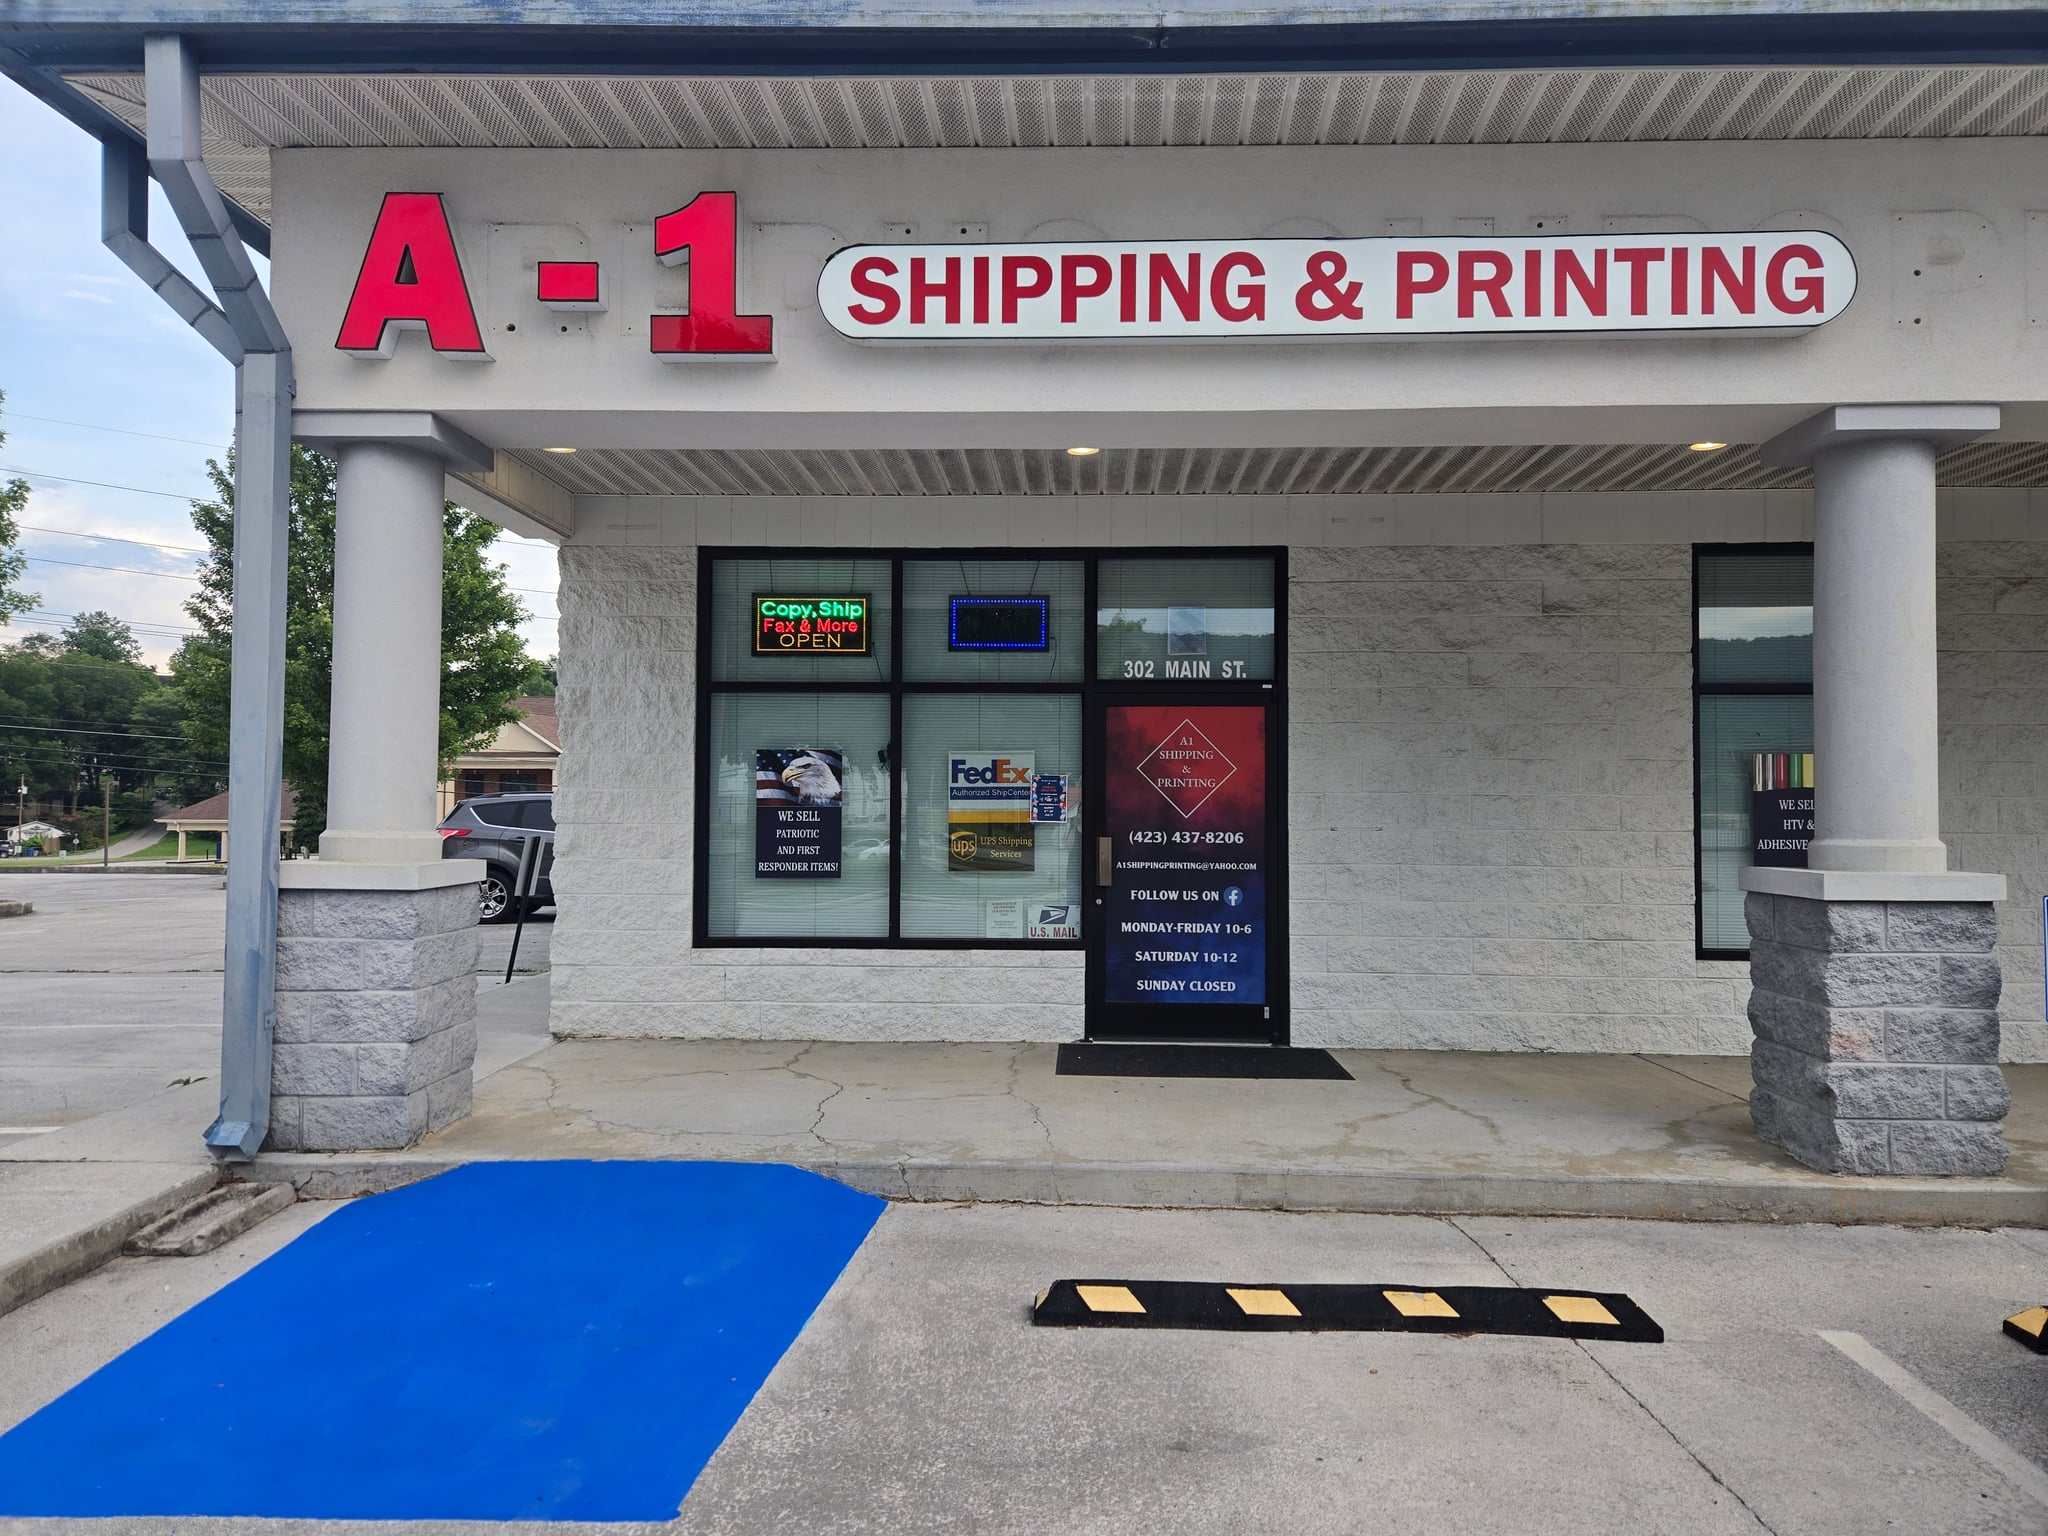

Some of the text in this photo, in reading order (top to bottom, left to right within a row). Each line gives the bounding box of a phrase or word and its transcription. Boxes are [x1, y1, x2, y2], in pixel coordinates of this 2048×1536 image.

[847, 243, 1826, 325] SHIPPING & PRINTING
[763, 618, 858, 633] Fax & More
[779, 633, 841, 648] OPEN
[1124, 660, 1247, 679] 302 MAIN ST.
[1180, 736, 1194, 746] A1
[1159, 750, 1214, 760] SHIPPING
[951, 759, 1031, 784] FedEx
[1182, 765, 1192, 774] &
[1157, 778, 1216, 788] PRINTING
[952, 788, 990, 796] Authorized
[991, 788, 1030, 798] ShipCente
[1779, 799, 1815, 810] WE SEL
[778, 810, 821, 822] WE SELL
[1783, 819, 1815, 830] HTV &
[776, 829, 820, 838] PATRIOTIC
[1129, 831, 1244, 845] (423) 437-8206
[980, 836, 1033, 848] UPS Shipping
[1757, 839, 1809, 850] ADHESIVE
[776, 845, 821, 855] AND FIRST
[990, 849, 1022, 859] Services
[758, 862, 839, 872] RESPONDER ITEMS!
[1130, 890, 1179, 901] FOLLOW
[1182, 890, 1199, 901] US
[1202, 891, 1219, 902] ON
[1030, 926, 1077, 938] U.S. MAIL
[1121, 922, 1252, 934] MONDAY-FRIDAY 10-6
[1135, 951, 1237, 963] SATURDAY 10-12
[1136, 980, 1236, 992] SUNDAY CLOSED
